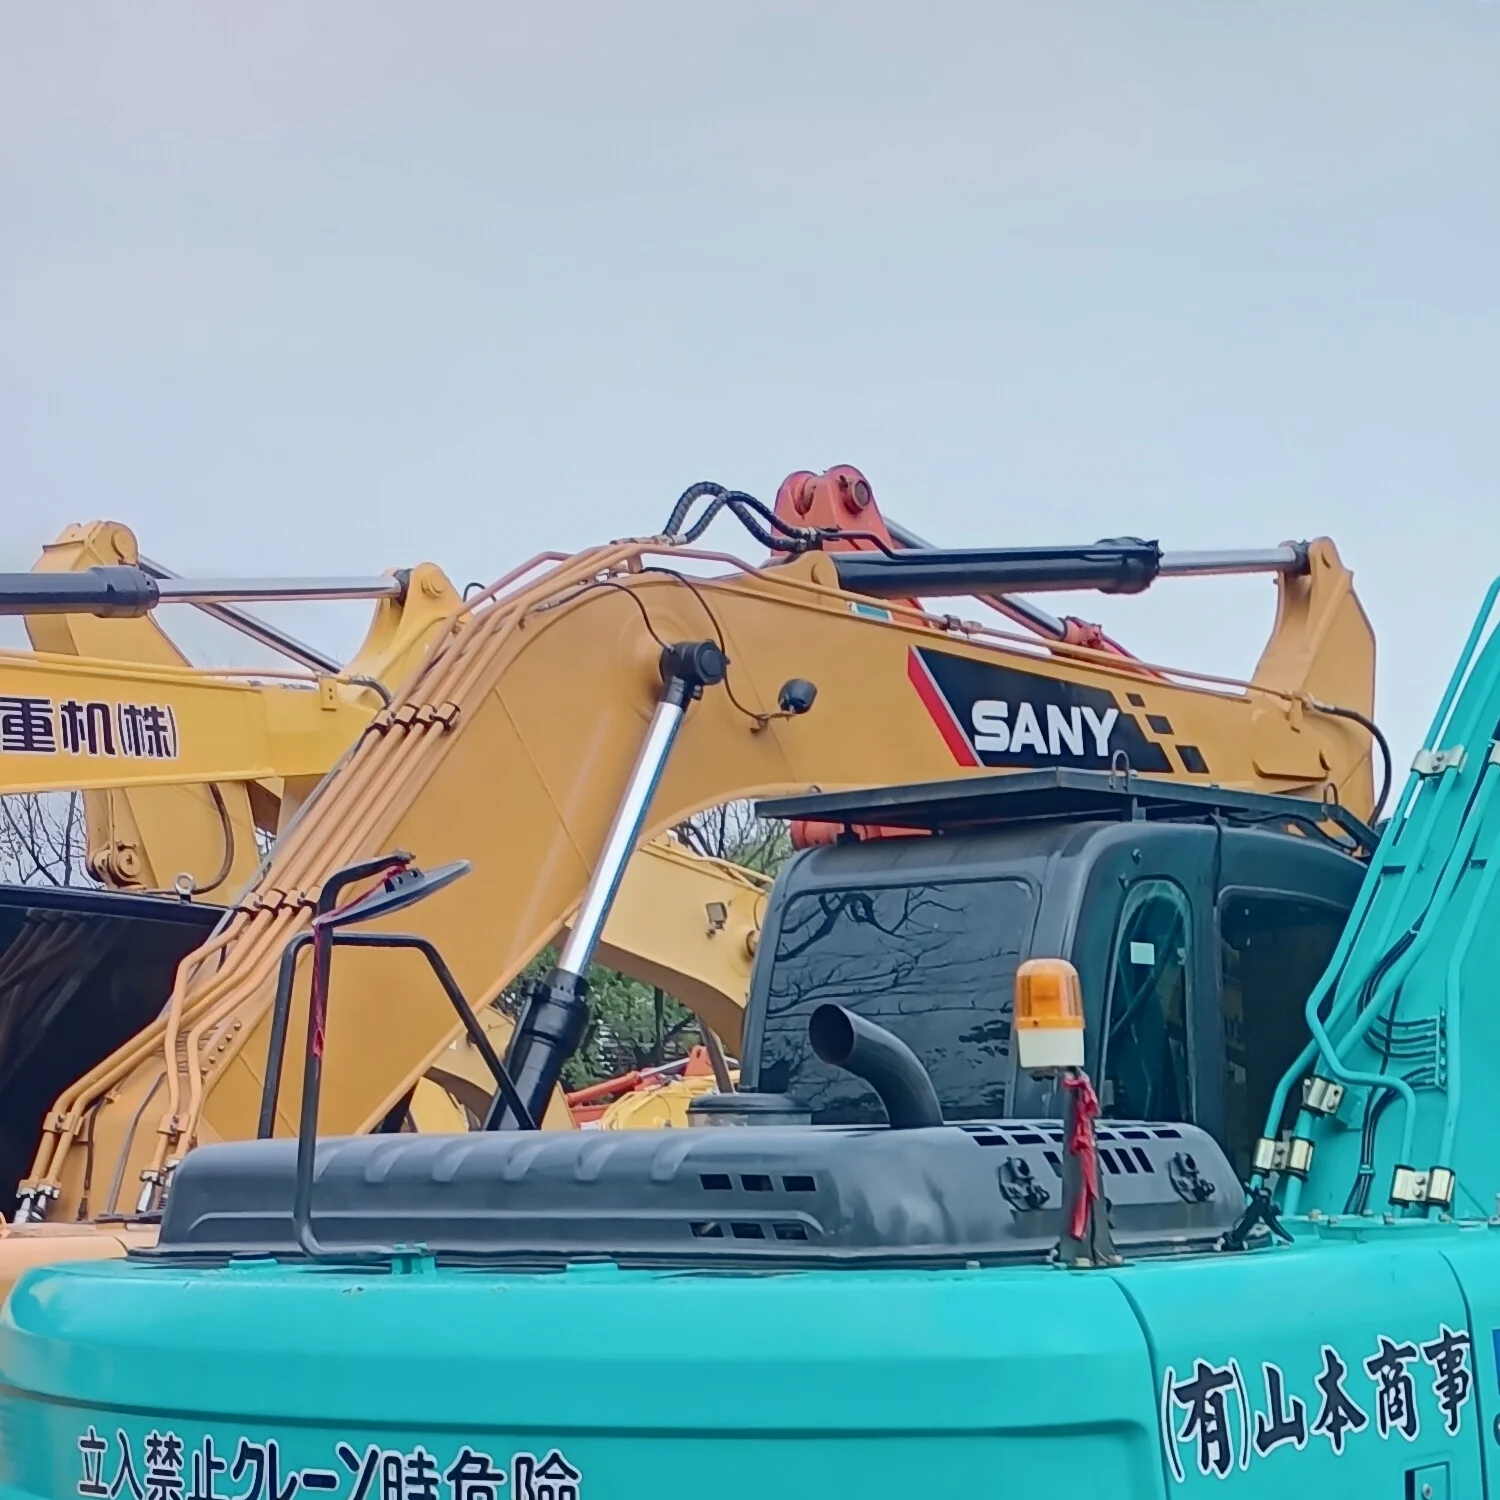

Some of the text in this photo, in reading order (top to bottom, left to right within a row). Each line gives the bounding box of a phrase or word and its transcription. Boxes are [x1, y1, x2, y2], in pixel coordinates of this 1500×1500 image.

[972, 700, 1119, 757] SANY
[1161, 1324, 1473, 1483] (有)山本商事
